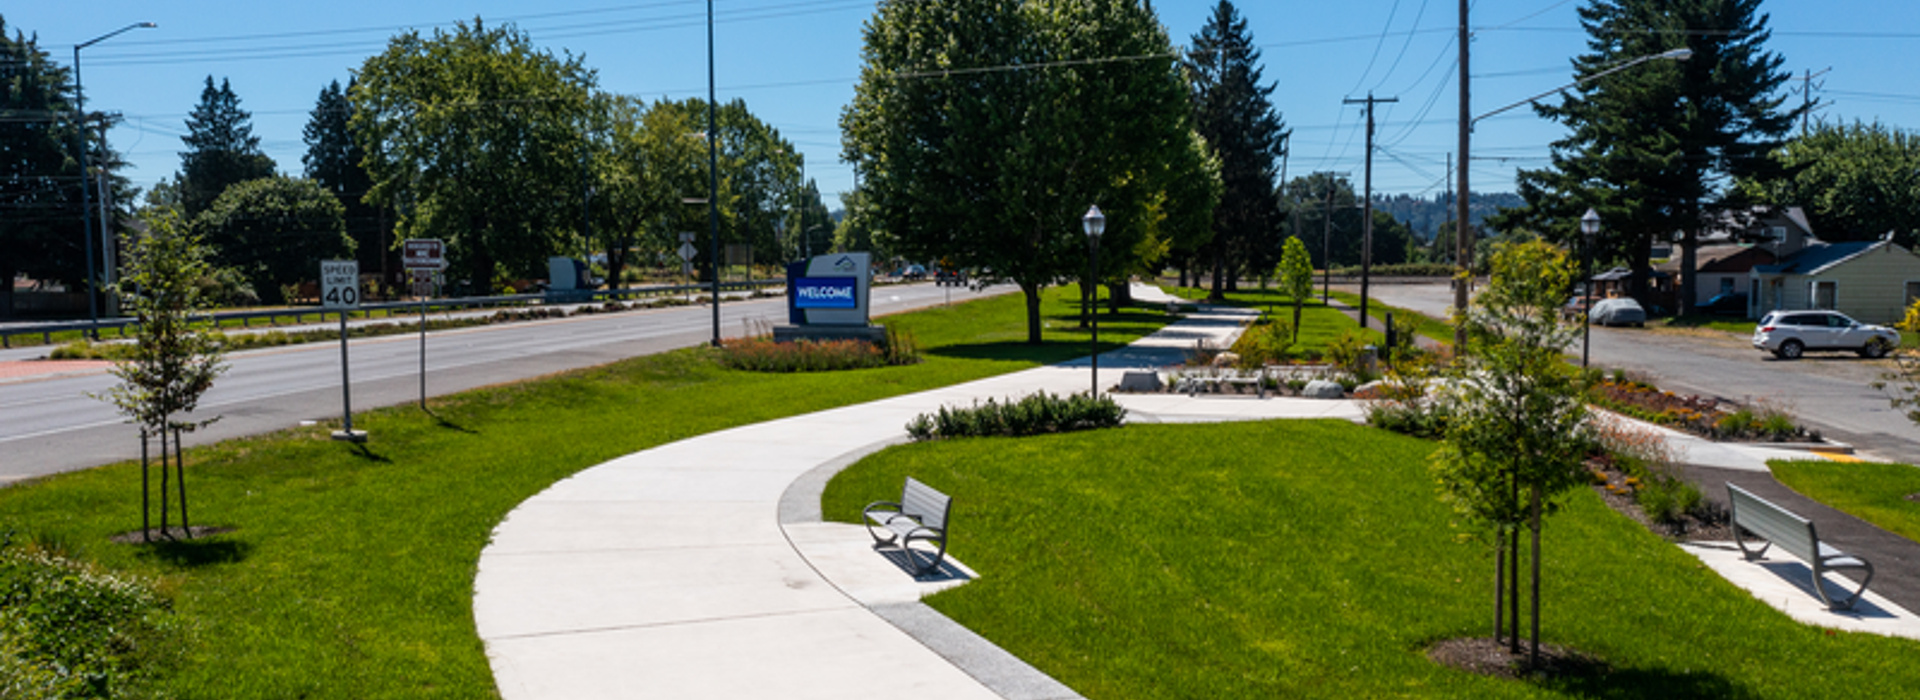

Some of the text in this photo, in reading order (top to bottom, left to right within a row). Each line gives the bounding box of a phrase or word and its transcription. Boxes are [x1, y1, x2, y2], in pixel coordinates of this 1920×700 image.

[323, 265, 356, 275] SPEED
[326, 276, 352, 285] LIMIT
[326, 286, 356, 305] 40
[796, 286, 852, 299] WELCOME
